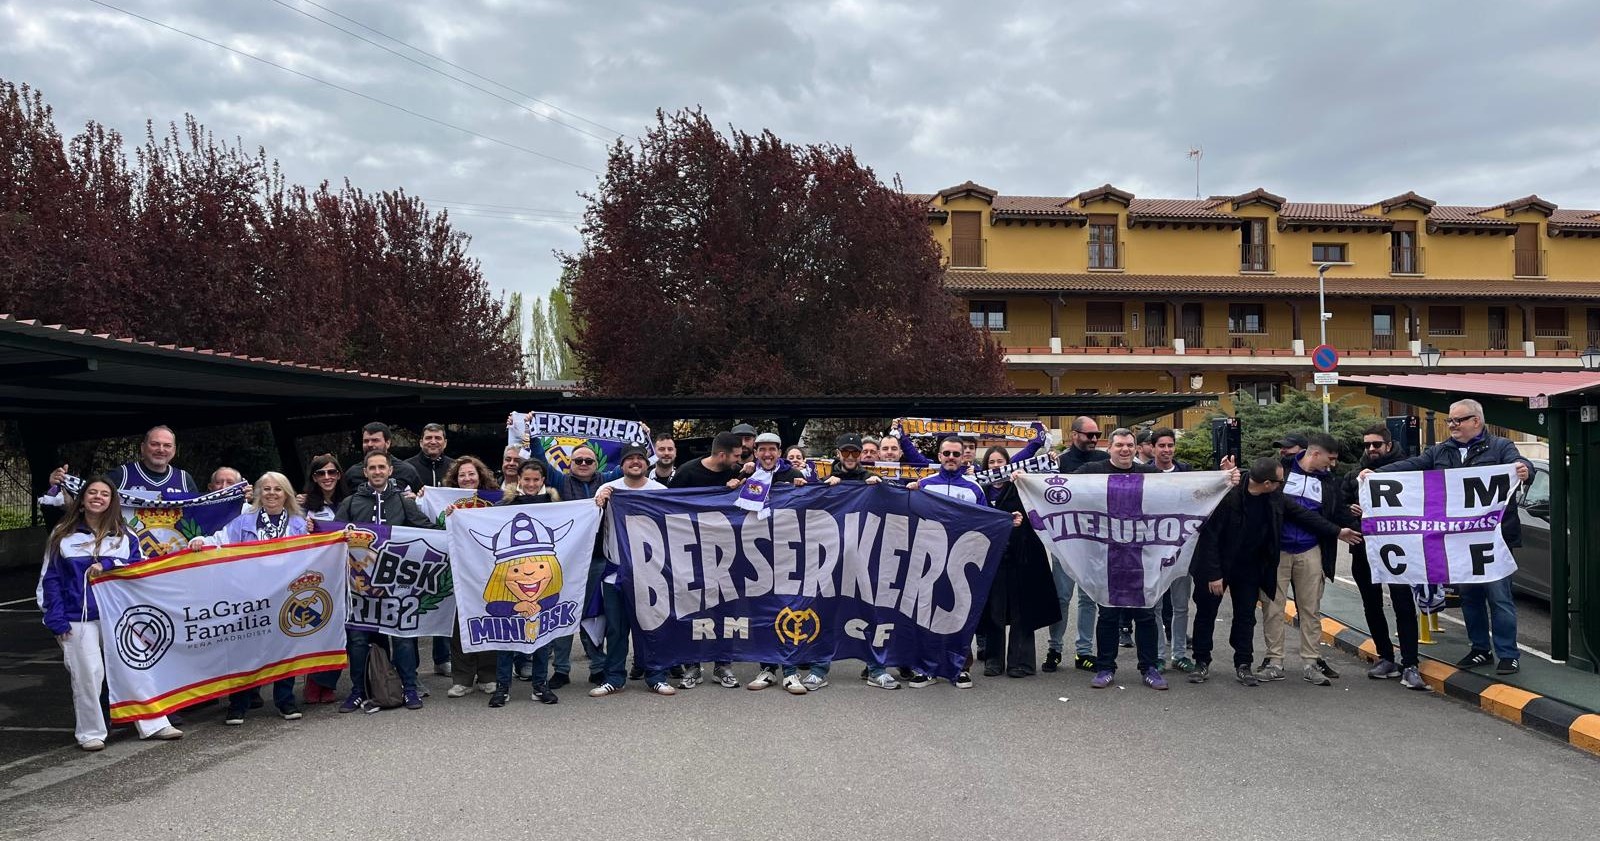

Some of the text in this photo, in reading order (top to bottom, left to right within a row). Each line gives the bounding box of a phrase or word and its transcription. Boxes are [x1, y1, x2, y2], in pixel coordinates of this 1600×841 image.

[1369, 473, 1511, 508] R M
[1042, 512, 1204, 543] VIEJUNOS
[1376, 515, 1499, 533] BERSERKERS
[372, 550, 448, 594] BSK
[626, 508, 992, 635] BERSERKERS
[1379, 542, 1495, 576] C F
[185, 613, 272, 643] Familia
[216, 628, 273, 644] MADRIDISTA
[469, 602, 577, 645] MINI BSK
